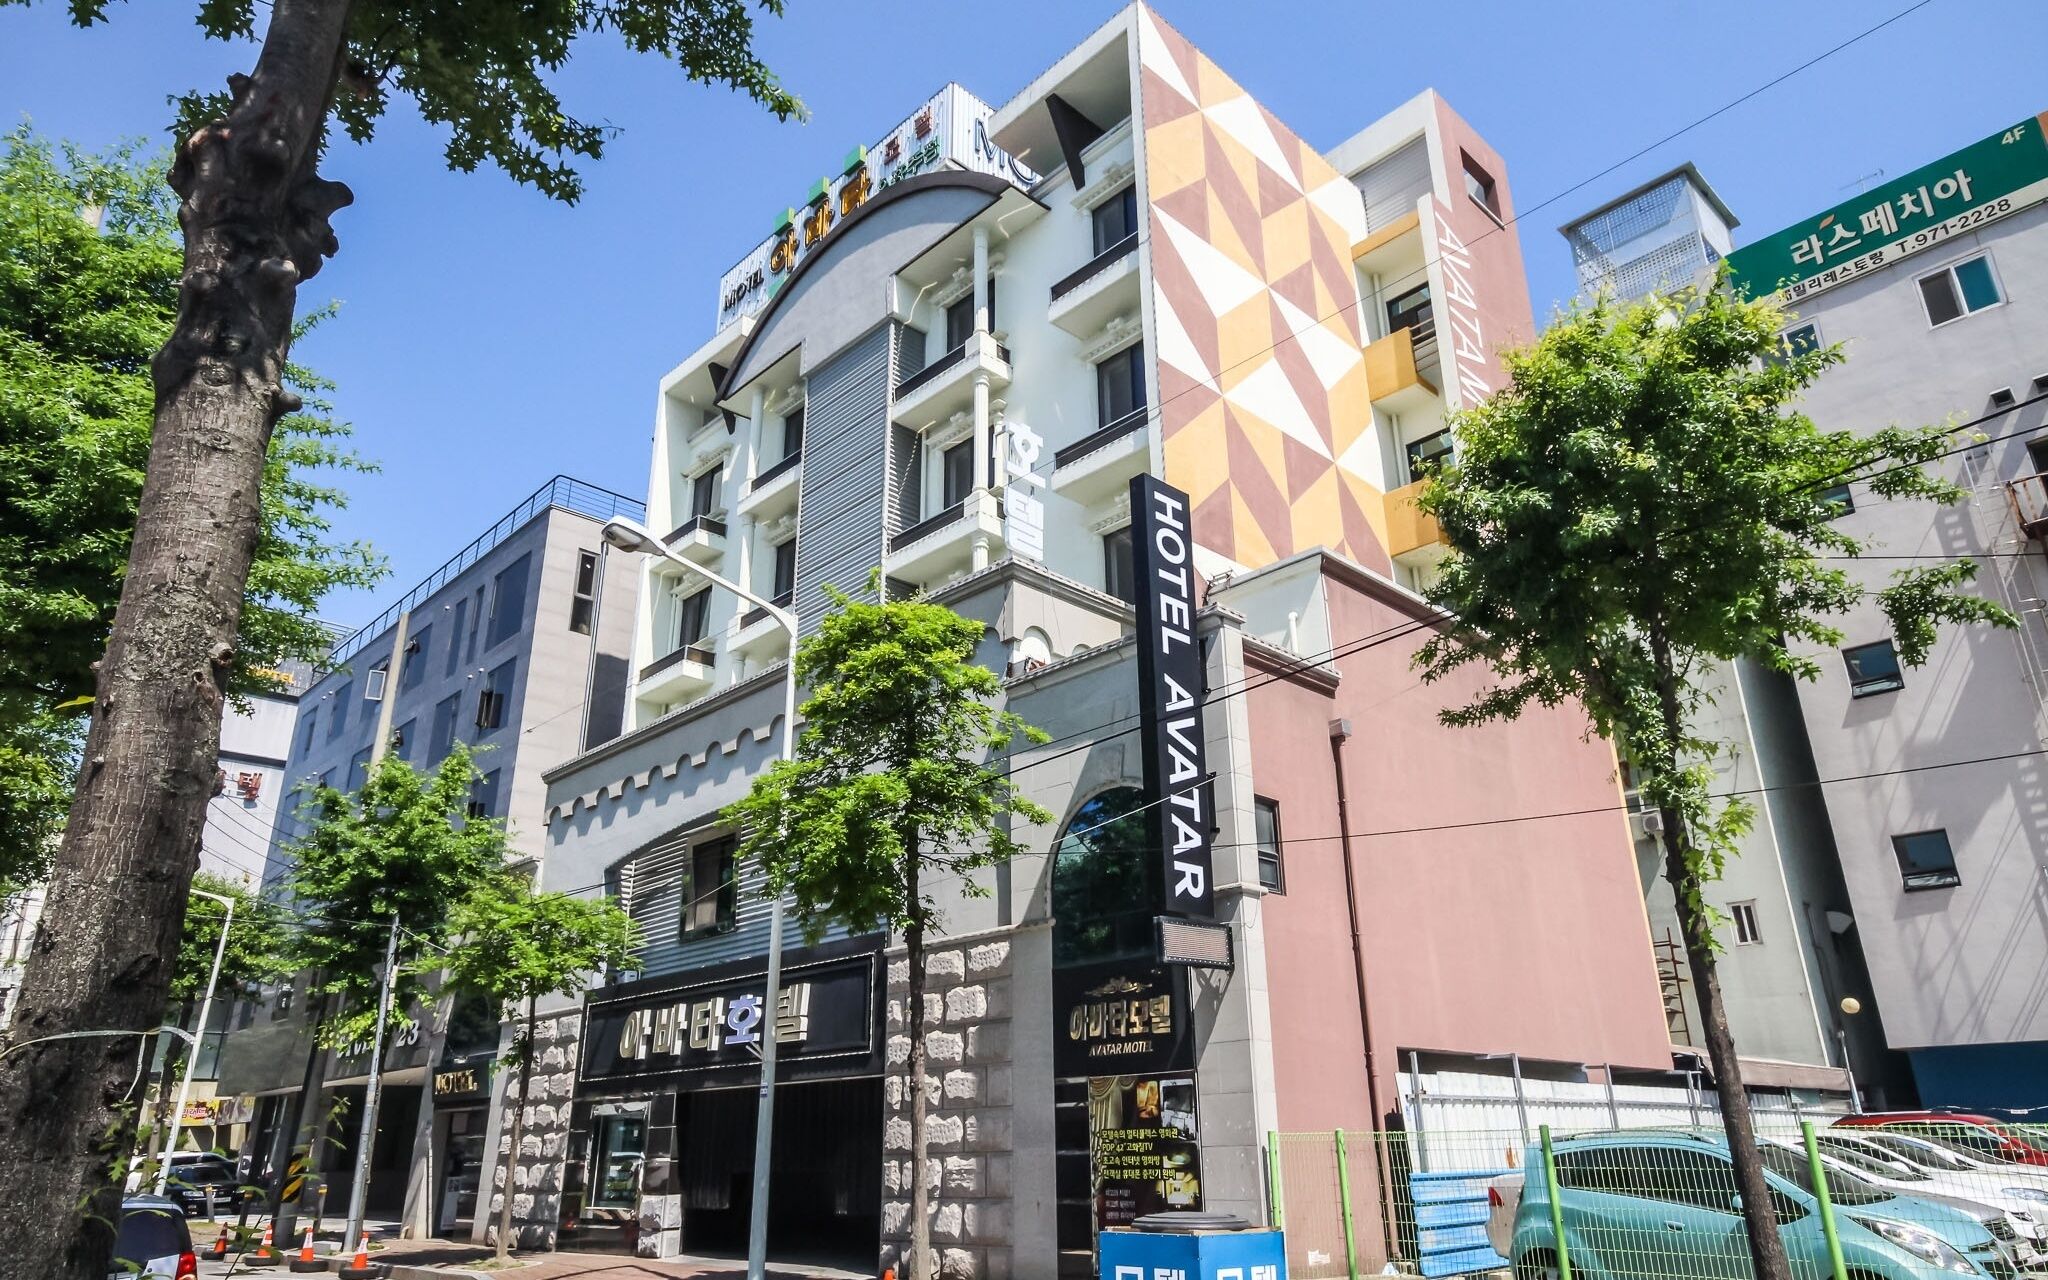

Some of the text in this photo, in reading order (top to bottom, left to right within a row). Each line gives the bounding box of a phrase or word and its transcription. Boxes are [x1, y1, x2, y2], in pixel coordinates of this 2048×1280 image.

[2001, 126, 2026, 145] 4F
[1790, 168, 1973, 266] 라스페치아
[1896, 198, 2012, 254] T.971-2228
[724, 267, 765, 312] MOTEL
[1004, 420, 1046, 562] 호텔
[1153, 490, 1205, 899] HOTEL AVATAR
[619, 983, 811, 1060] 아바타호텔
[1070, 995, 1171, 1040] 아바타모텔
[1089, 1041, 1153, 1057] AVATAR MOTEL
